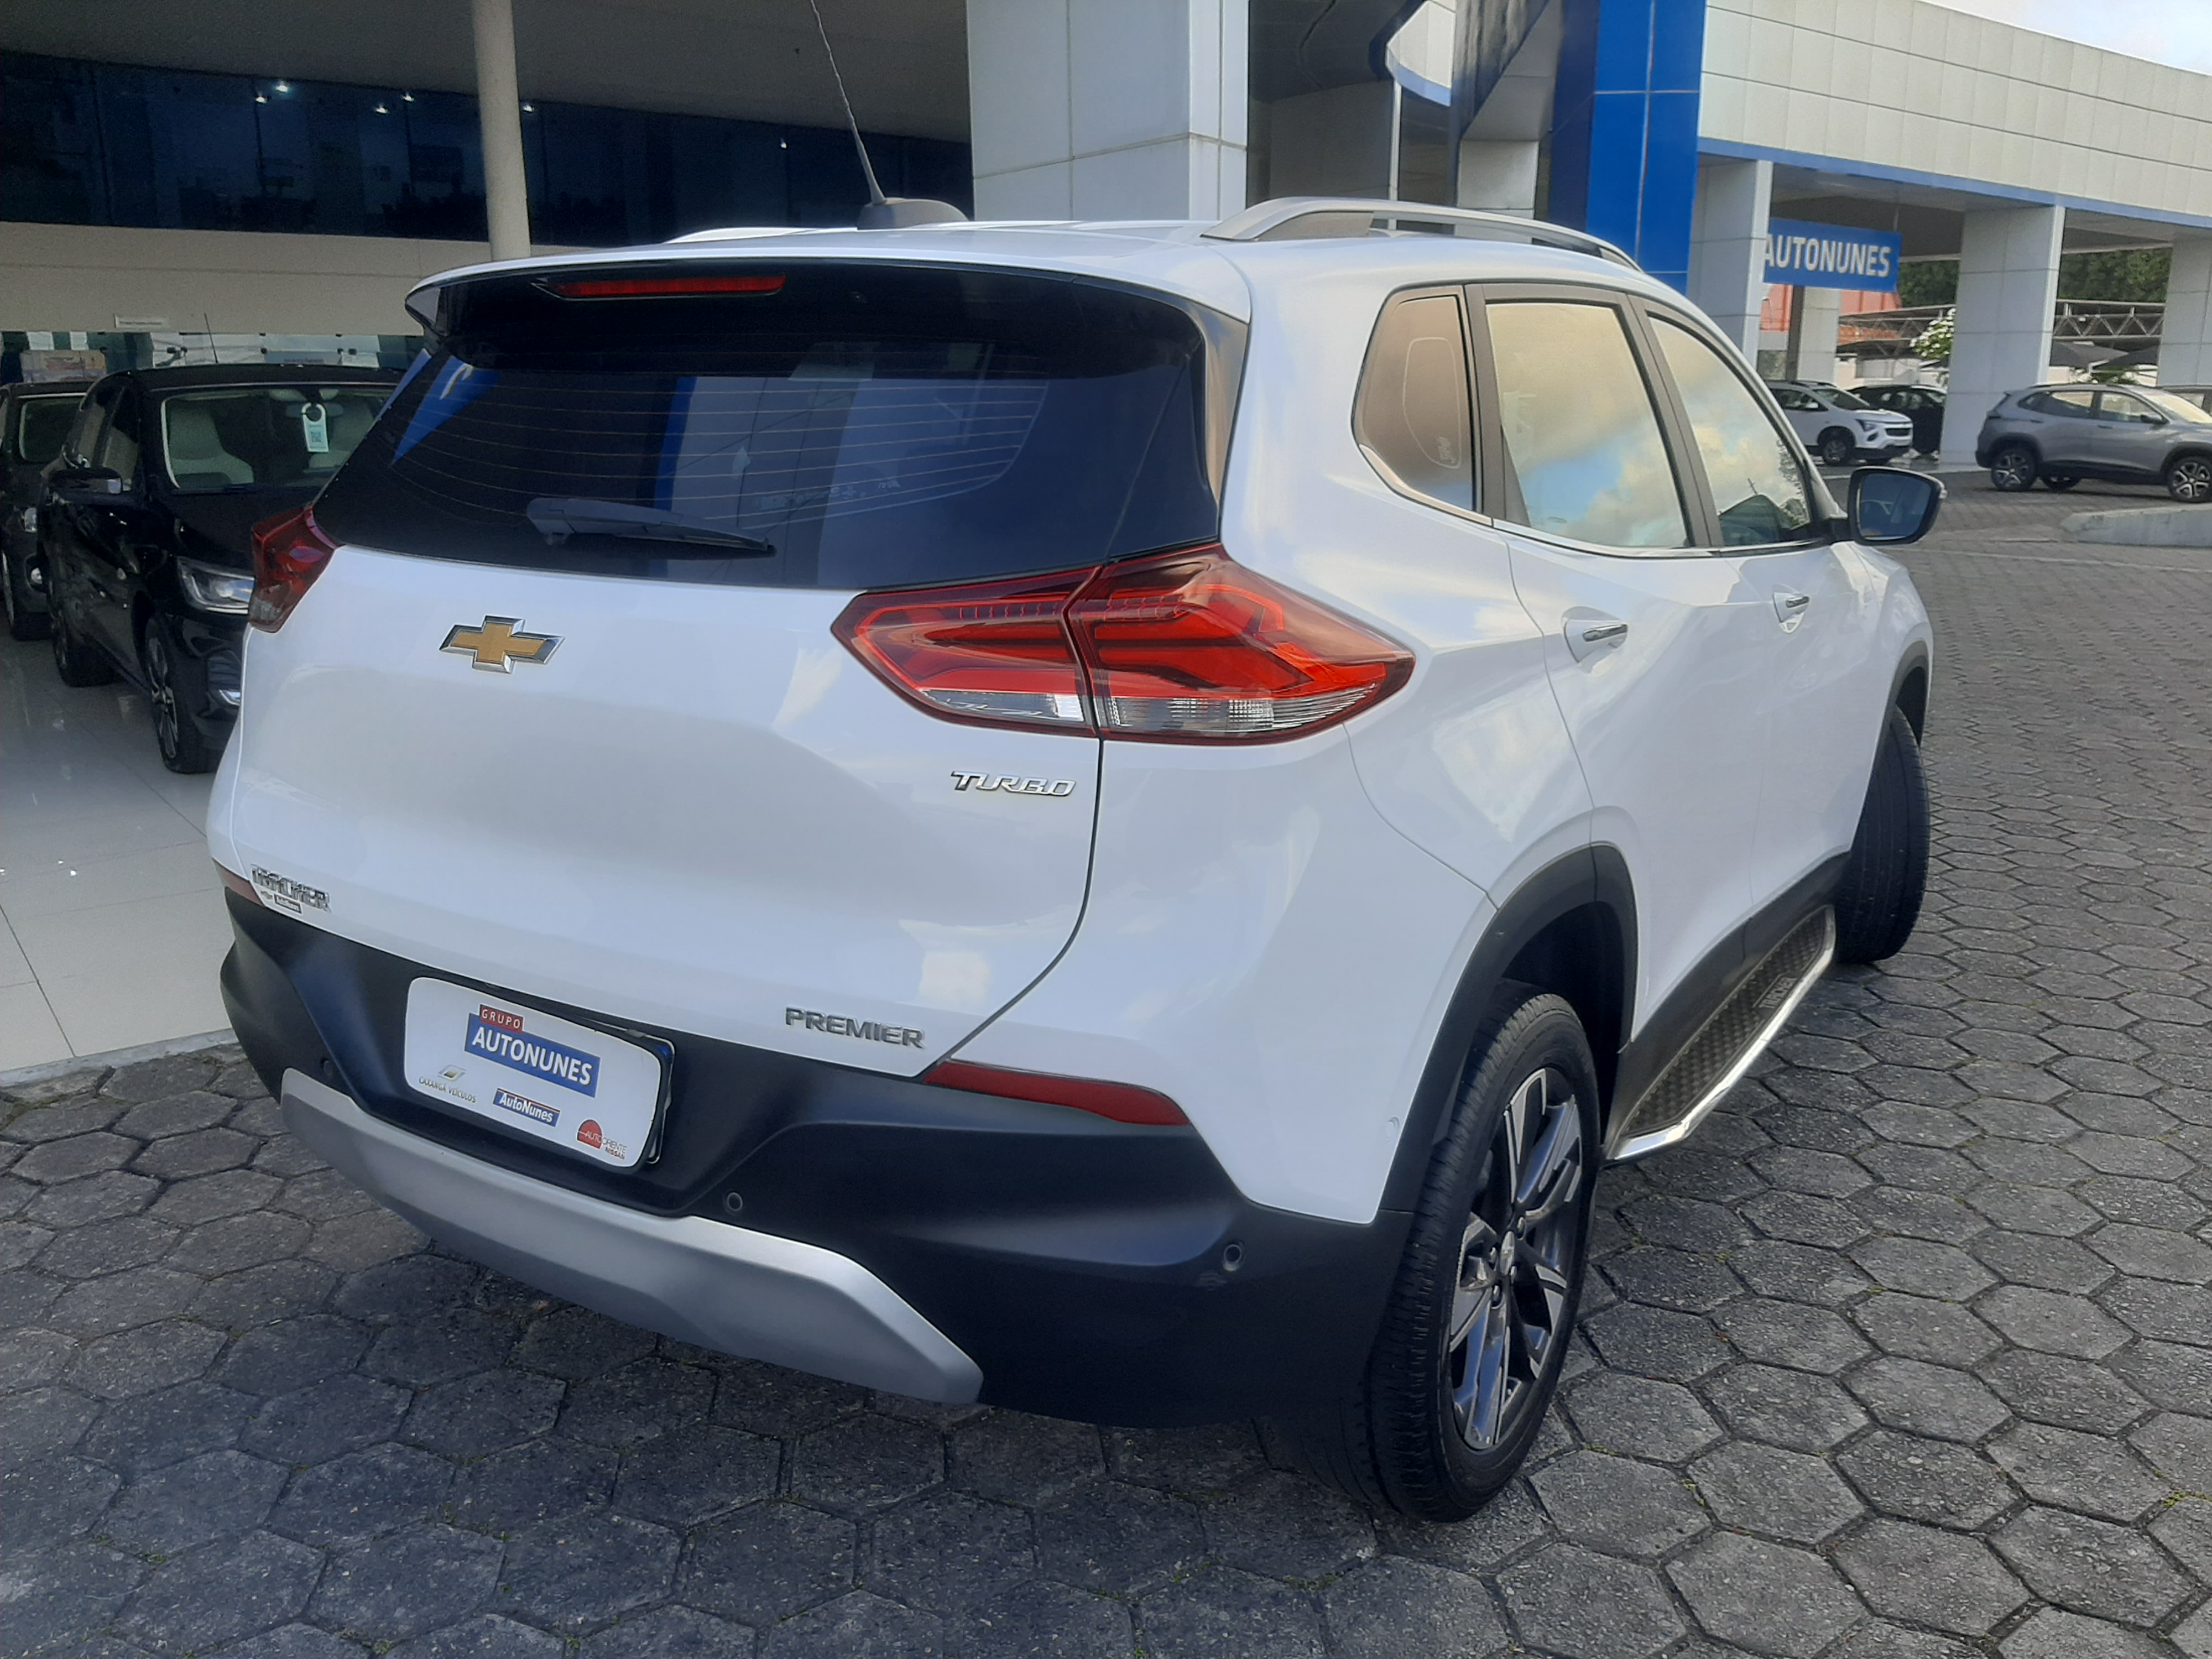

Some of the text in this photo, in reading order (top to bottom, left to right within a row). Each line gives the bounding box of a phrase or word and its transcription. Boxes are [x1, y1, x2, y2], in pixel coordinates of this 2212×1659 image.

[1765, 234, 1892, 278] AUTONUNES
[951, 771, 1077, 797] TURBO
[481, 1009, 521, 1029] GRUPO
[785, 1006, 928, 1049] PREMIER
[472, 1026, 593, 1086] AUTONUNES
[499, 1093, 554, 1123] AutoNunes
